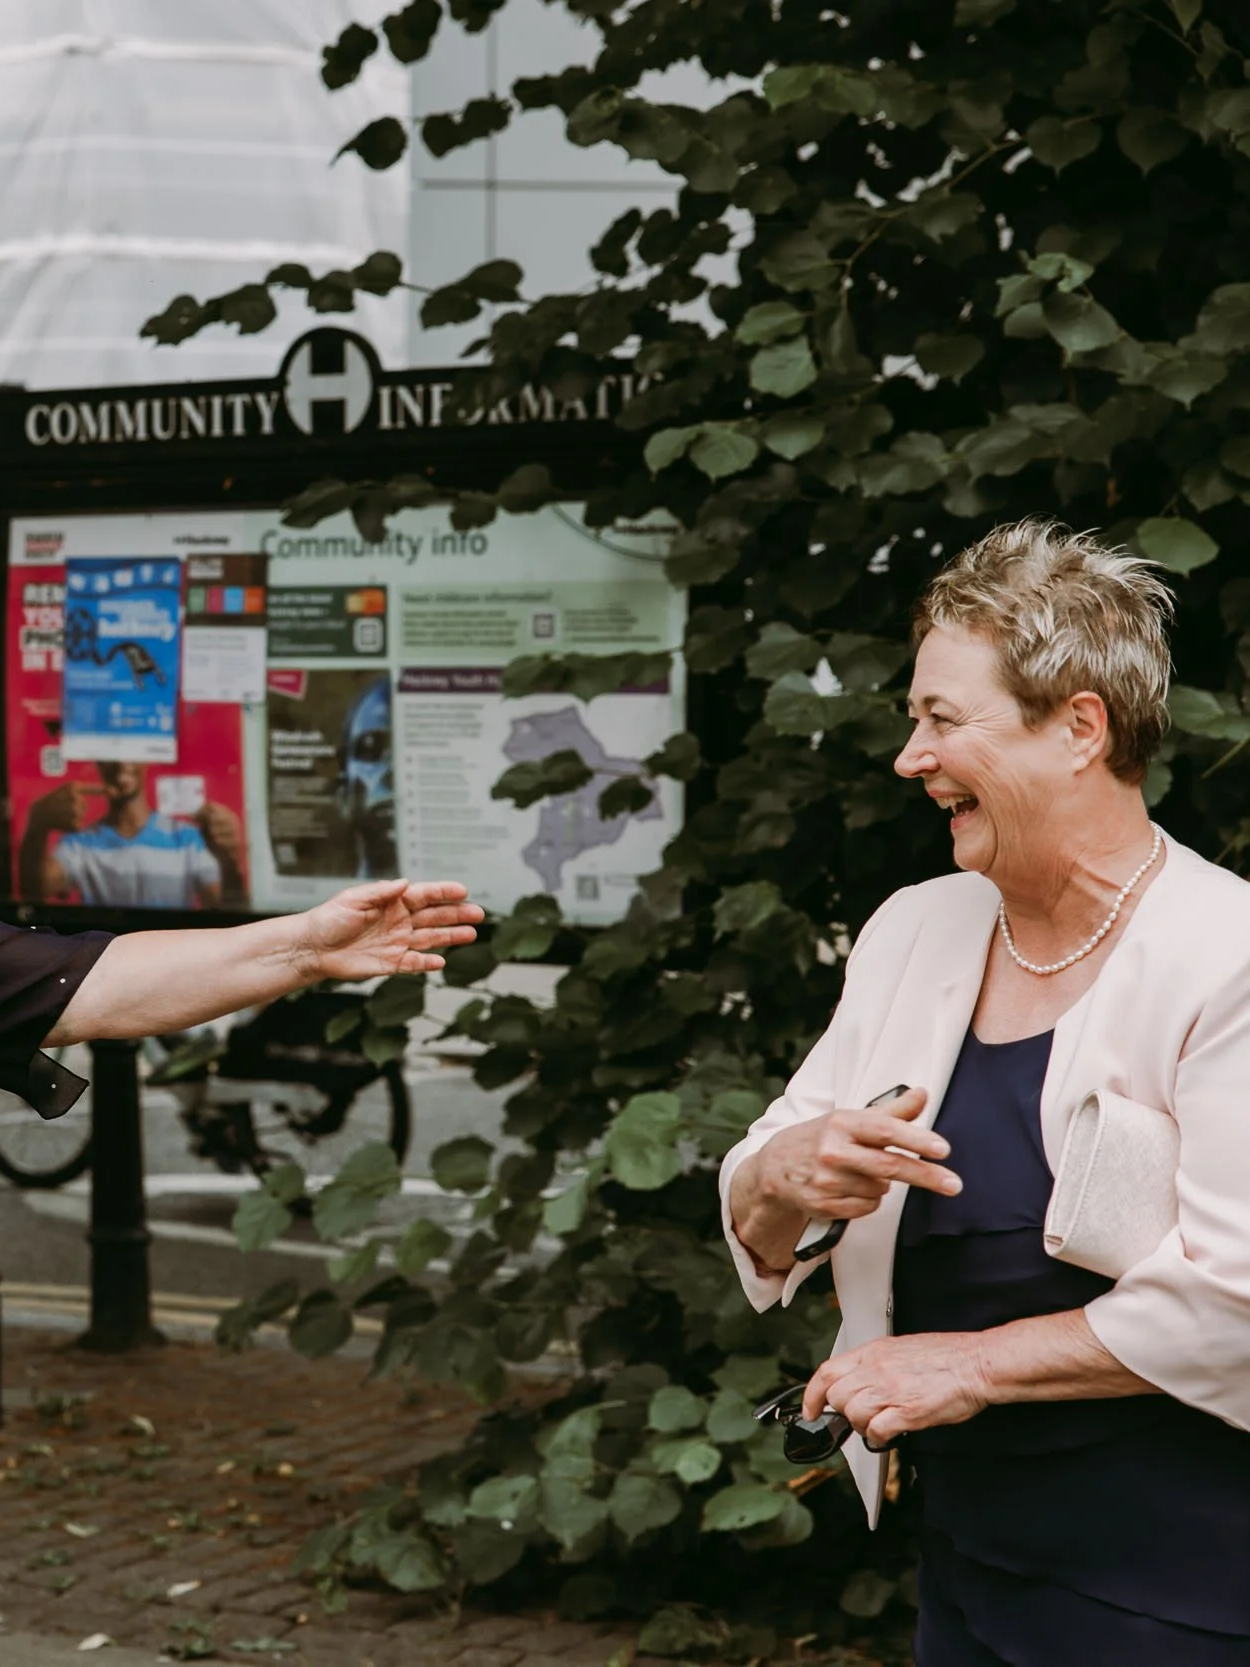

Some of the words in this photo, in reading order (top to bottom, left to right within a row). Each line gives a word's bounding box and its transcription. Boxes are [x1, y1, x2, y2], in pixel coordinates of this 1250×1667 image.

[25, 391, 280, 446] COMMUNITY
[285, 341, 372, 435] H
[261, 528, 423, 564] Community
[432, 527, 490, 556] info
